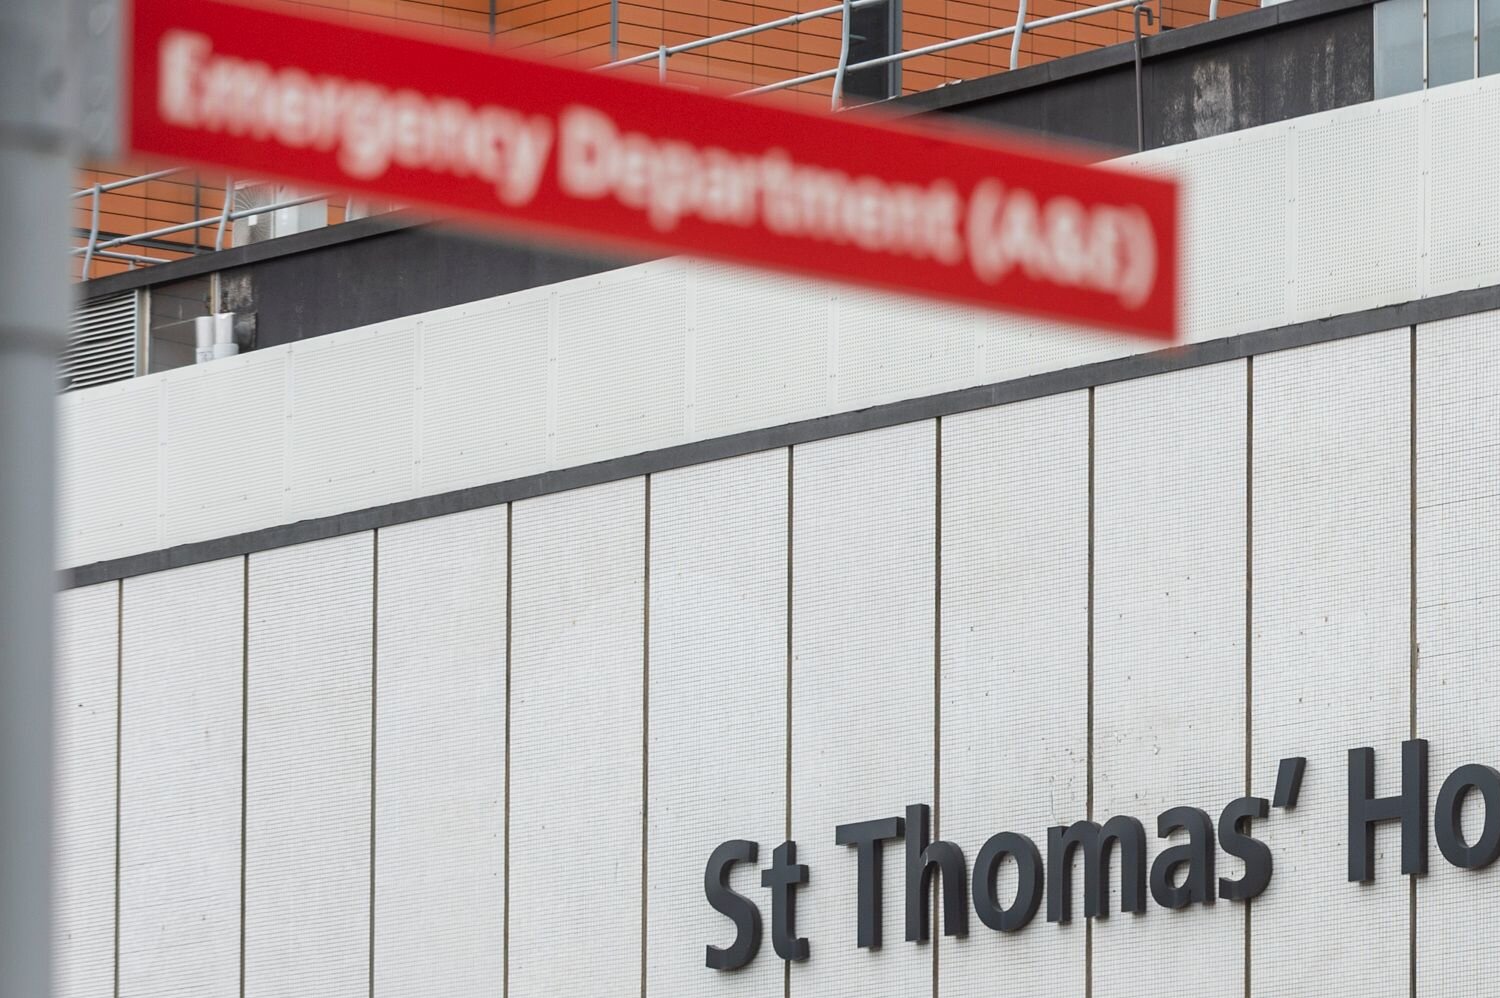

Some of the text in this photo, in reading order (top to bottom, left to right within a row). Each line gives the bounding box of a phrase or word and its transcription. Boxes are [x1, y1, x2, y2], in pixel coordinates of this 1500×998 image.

[160, 30, 1158, 310] Emergency Department (A&E)
[704, 839, 809, 971] St
